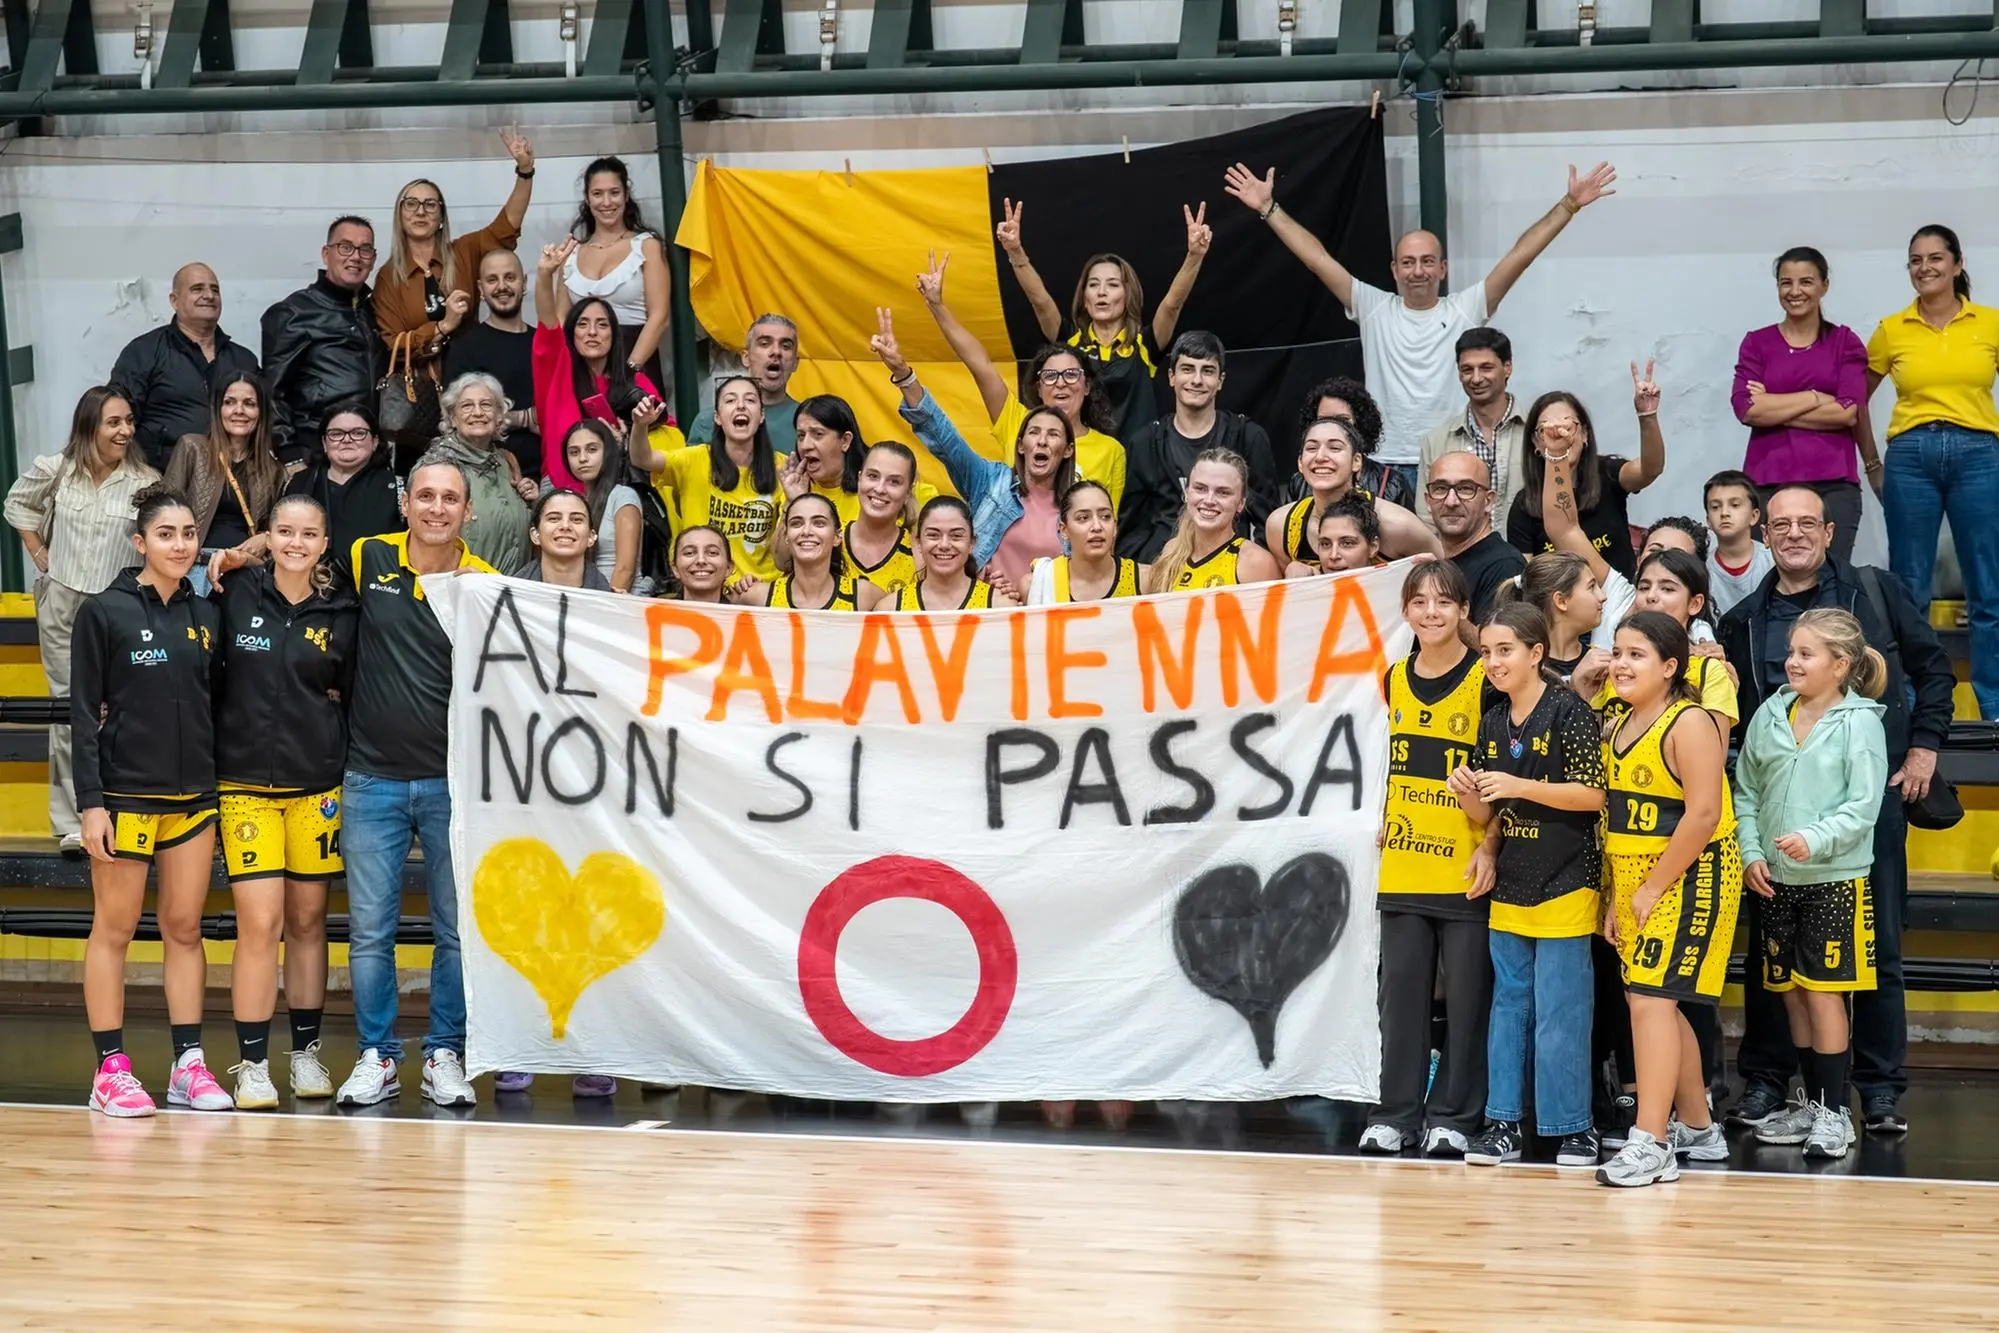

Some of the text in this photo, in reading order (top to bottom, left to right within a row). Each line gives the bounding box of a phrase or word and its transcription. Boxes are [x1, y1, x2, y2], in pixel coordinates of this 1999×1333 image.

[131, 648, 168, 662] ICOM
[236, 633, 271, 648] ICOM
[473, 575, 1389, 726] AL PALAVIENNA
[481, 707, 1362, 831] NON SI PASSA
[1444, 748, 1469, 777] 17
[1627, 798, 1659, 832] 29
[315, 828, 342, 860] 14
[1381, 821, 1455, 858] Petrarca
[1677, 851, 1715, 977] BSS SELARGIUS
[1632, 934, 1665, 970] 29
[1825, 940, 1841, 969] 5
